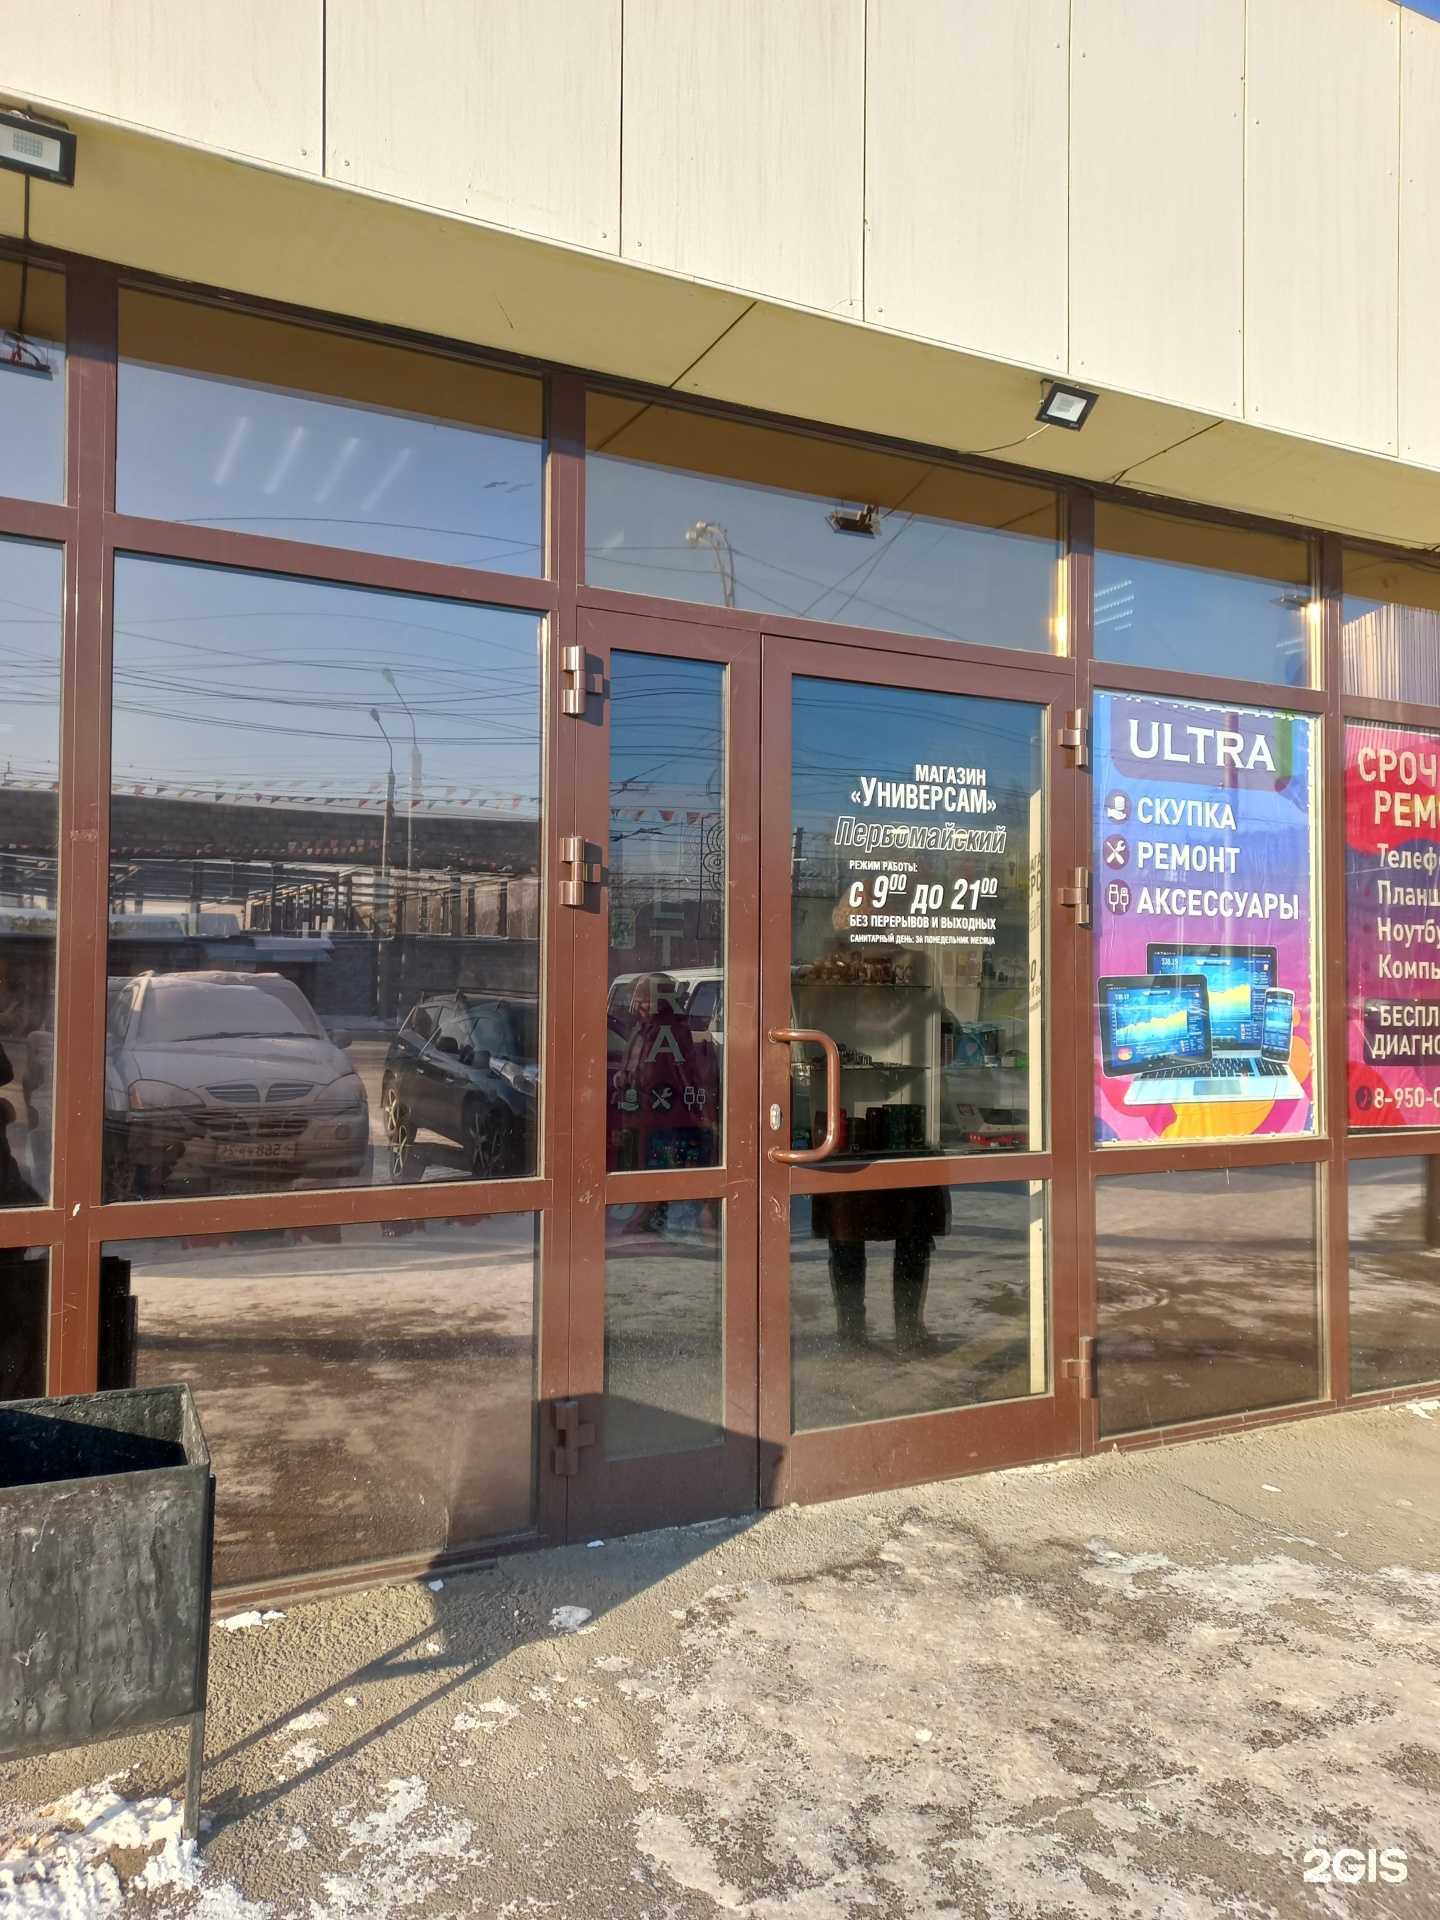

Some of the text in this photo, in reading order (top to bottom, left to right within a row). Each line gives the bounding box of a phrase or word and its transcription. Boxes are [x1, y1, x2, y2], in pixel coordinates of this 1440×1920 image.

[1128, 718, 1277, 772] ULTRA
[915, 764, 987, 787] МАГАЗИН
[1358, 746, 1437, 788] СРОЧ
[1137, 797, 1237, 831] СКУПКА
[1374, 789, 1440, 829] РЕМ
[834, 815, 1008, 854] Первомайский
[849, 860, 919, 873] РЕЖИМ РАБОТЫ:
[1137, 840, 1241, 874] РЕМОНТ
[1377, 843, 1440, 876] Телеф
[1136, 886, 1300, 921] АКСЕССУАРЫ
[849, 914, 997, 932] БЕЗ ПЕРЕРЫВОВ И ВЫХОДНЫХ
[850, 932, 896, 944] САНИТАРНЫЙ
[924, 935, 969, 946] ПОНЕДЕЛЬНИК
[1379, 1004, 1440, 1027] БЕСПЛ
